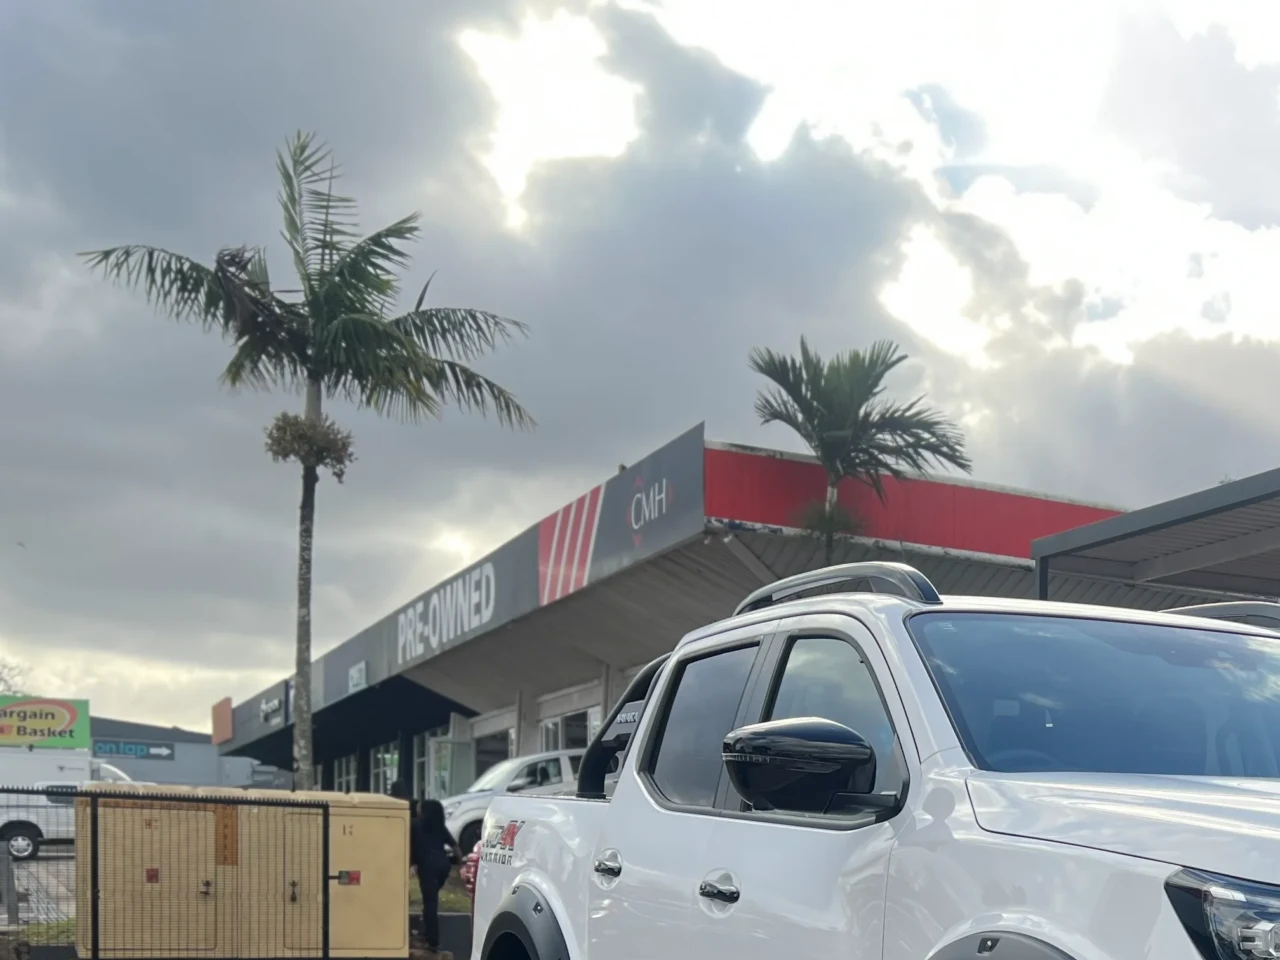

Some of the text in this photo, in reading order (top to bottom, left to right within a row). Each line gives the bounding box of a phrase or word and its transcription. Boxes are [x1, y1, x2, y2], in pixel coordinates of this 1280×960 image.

[631, 477, 666, 530] CMH
[397, 561, 496, 665] PRE-OWNED
[0, 709, 56, 721] argain
[16, 726, 75, 738] Basket
[95, 741, 148, 758] on tap
